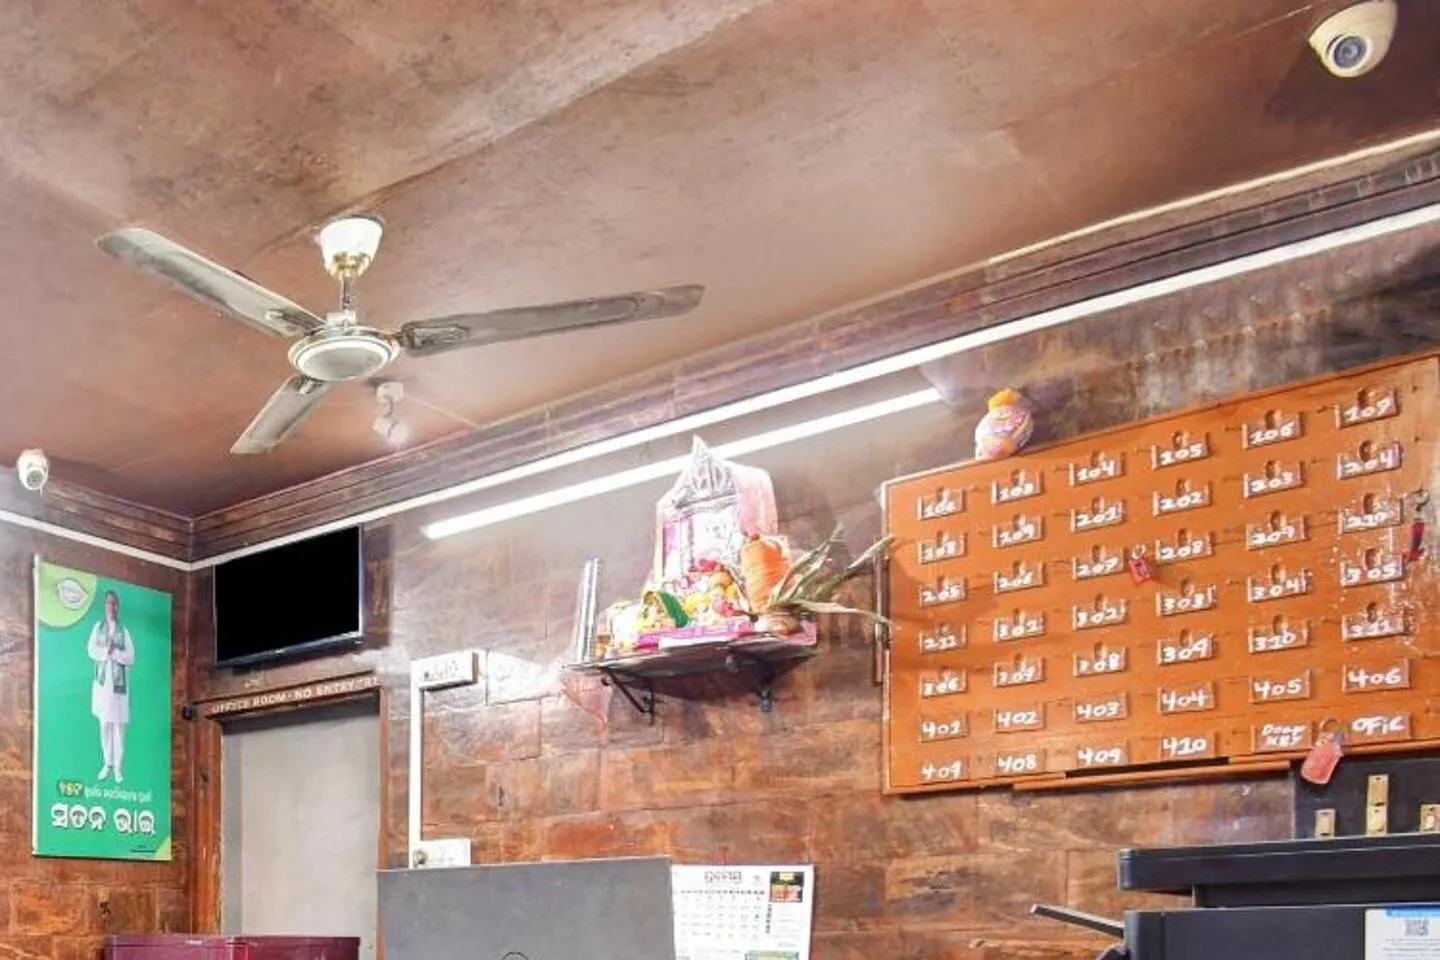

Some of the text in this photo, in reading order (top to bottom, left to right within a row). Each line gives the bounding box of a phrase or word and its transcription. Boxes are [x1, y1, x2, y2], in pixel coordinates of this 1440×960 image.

[1347, 667, 1402, 687] 406
[295, 688, 312, 700] NO
[1162, 689, 1209, 708] 404
[1253, 679, 1304, 699] 405
[997, 711, 1039, 727] 402
[1076, 701, 1121, 719] 403
[997, 754, 1037, 773] 408
